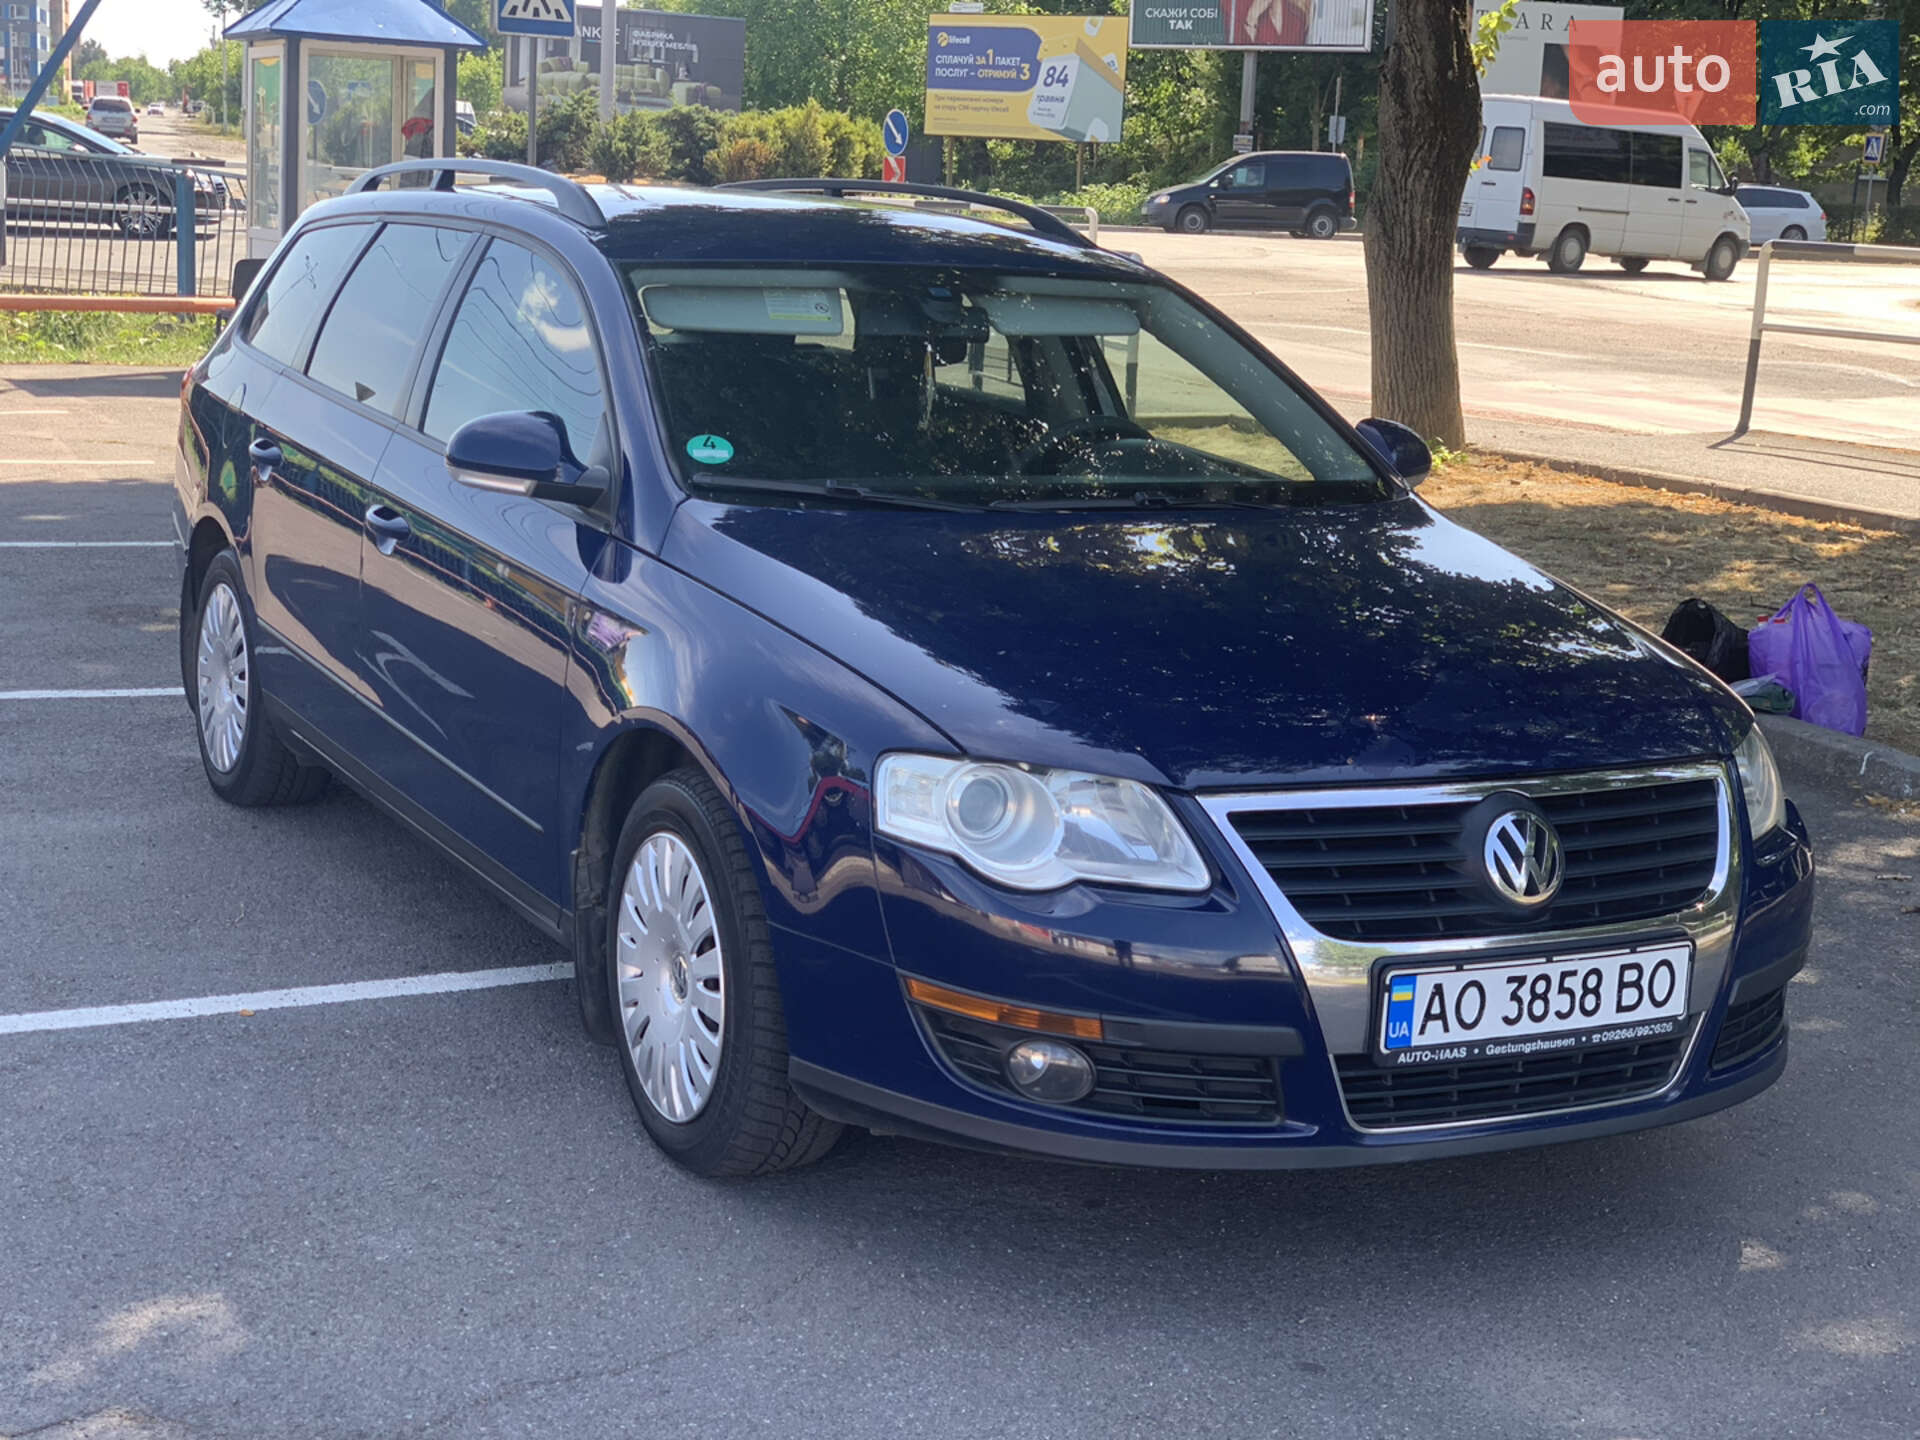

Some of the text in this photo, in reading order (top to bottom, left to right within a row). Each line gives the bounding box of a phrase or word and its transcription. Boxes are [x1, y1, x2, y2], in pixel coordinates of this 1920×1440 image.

[1145, 7, 1218, 18] СКАЖИ СОБІ
[1169, 20, 1193, 30] ТАК
[935, 48, 1021, 66] СПЛАЧУЙ ЗА 1 ПАКЕТ
[935, 68, 968, 78] ПОСЛУГ
[977, 68, 1017, 79] ОТРИМУЙ
[1020, 63, 1031, 80] 3
[1043, 65, 1069, 88] 84
[703, 436, 716, 449] 4
[1418, 958, 1676, 1036] AO 3858 BO
[1388, 1021, 1410, 1038] UA
